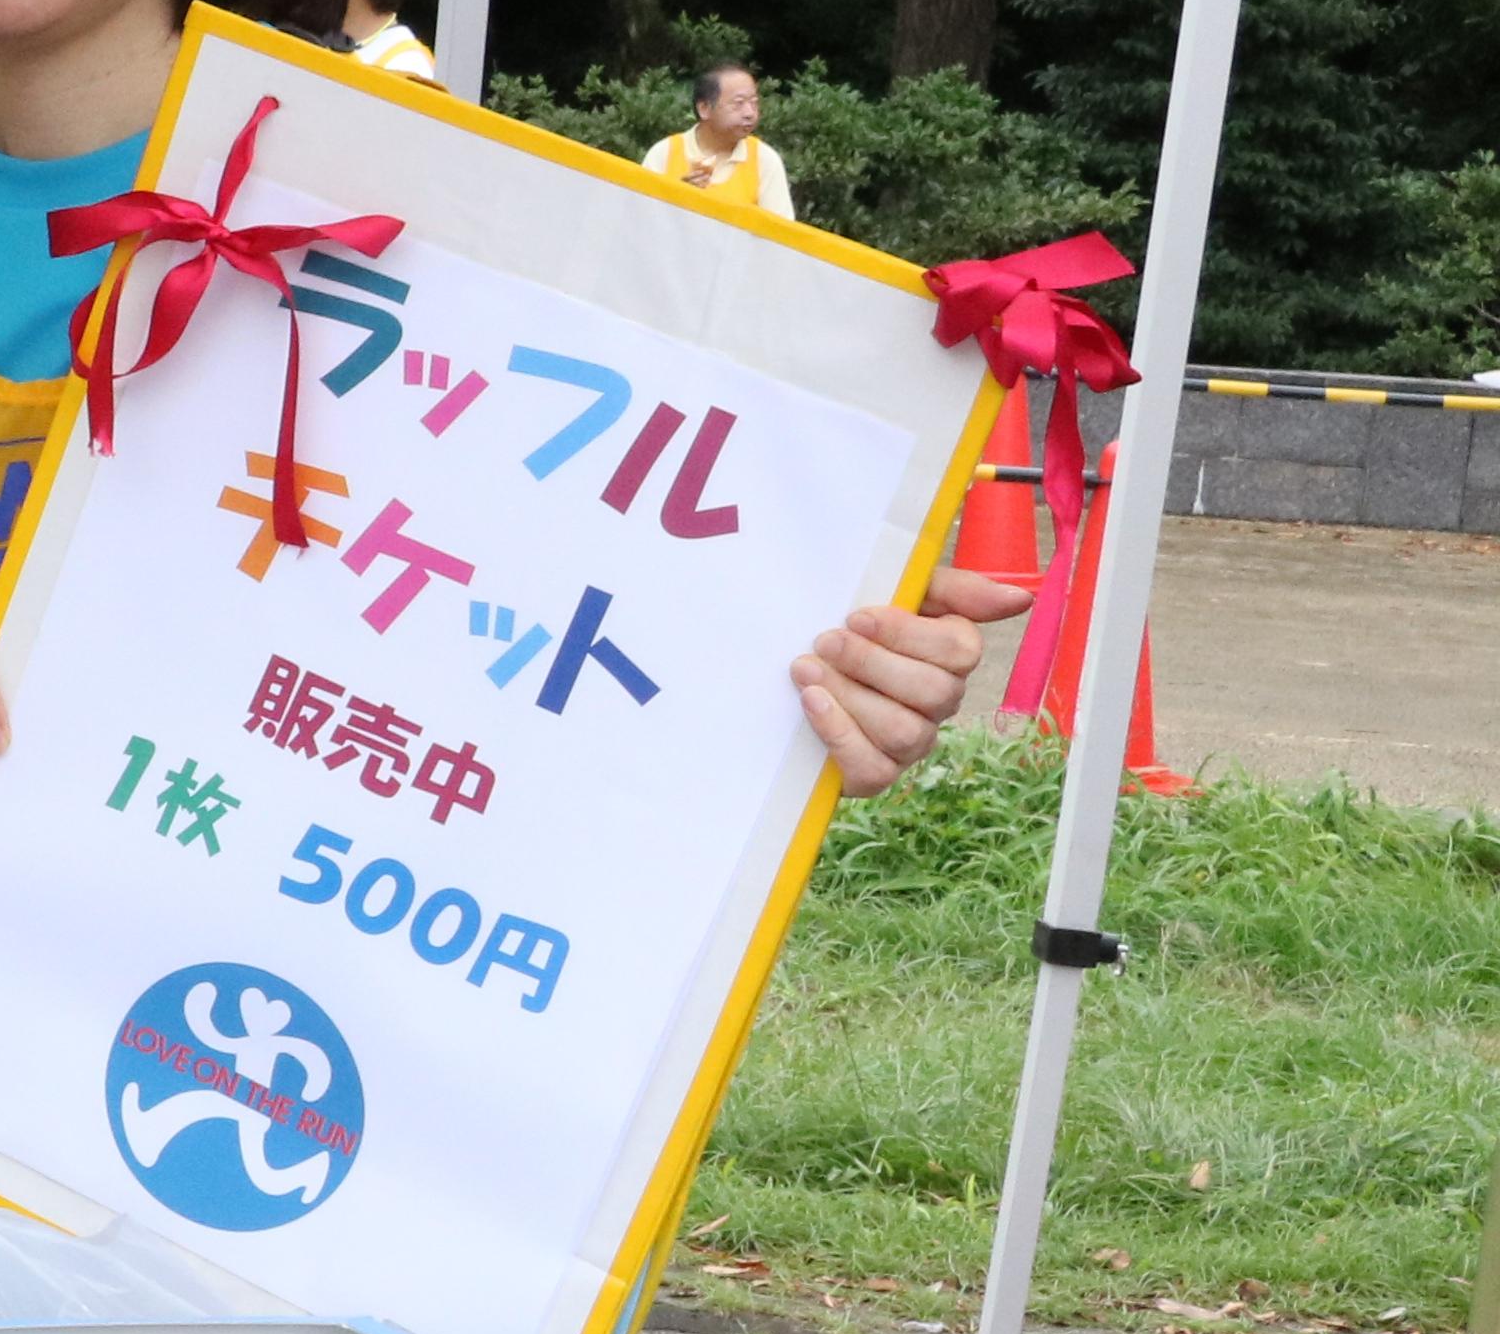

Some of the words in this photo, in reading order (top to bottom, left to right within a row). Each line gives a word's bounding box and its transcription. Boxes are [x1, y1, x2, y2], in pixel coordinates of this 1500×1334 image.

[278, 247, 740, 540] ラッフル
[215, 450, 662, 717] チケット
[242, 653, 498, 826] 販売中
[104, 733, 243, 858] 1枚
[278, 823, 571, 1014] 500円
[119, 1019, 195, 1074] LOVE
[192, 1057, 241, 1097] ON
[247, 1081, 297, 1125] THE
[295, 1107, 359, 1156] RUN
